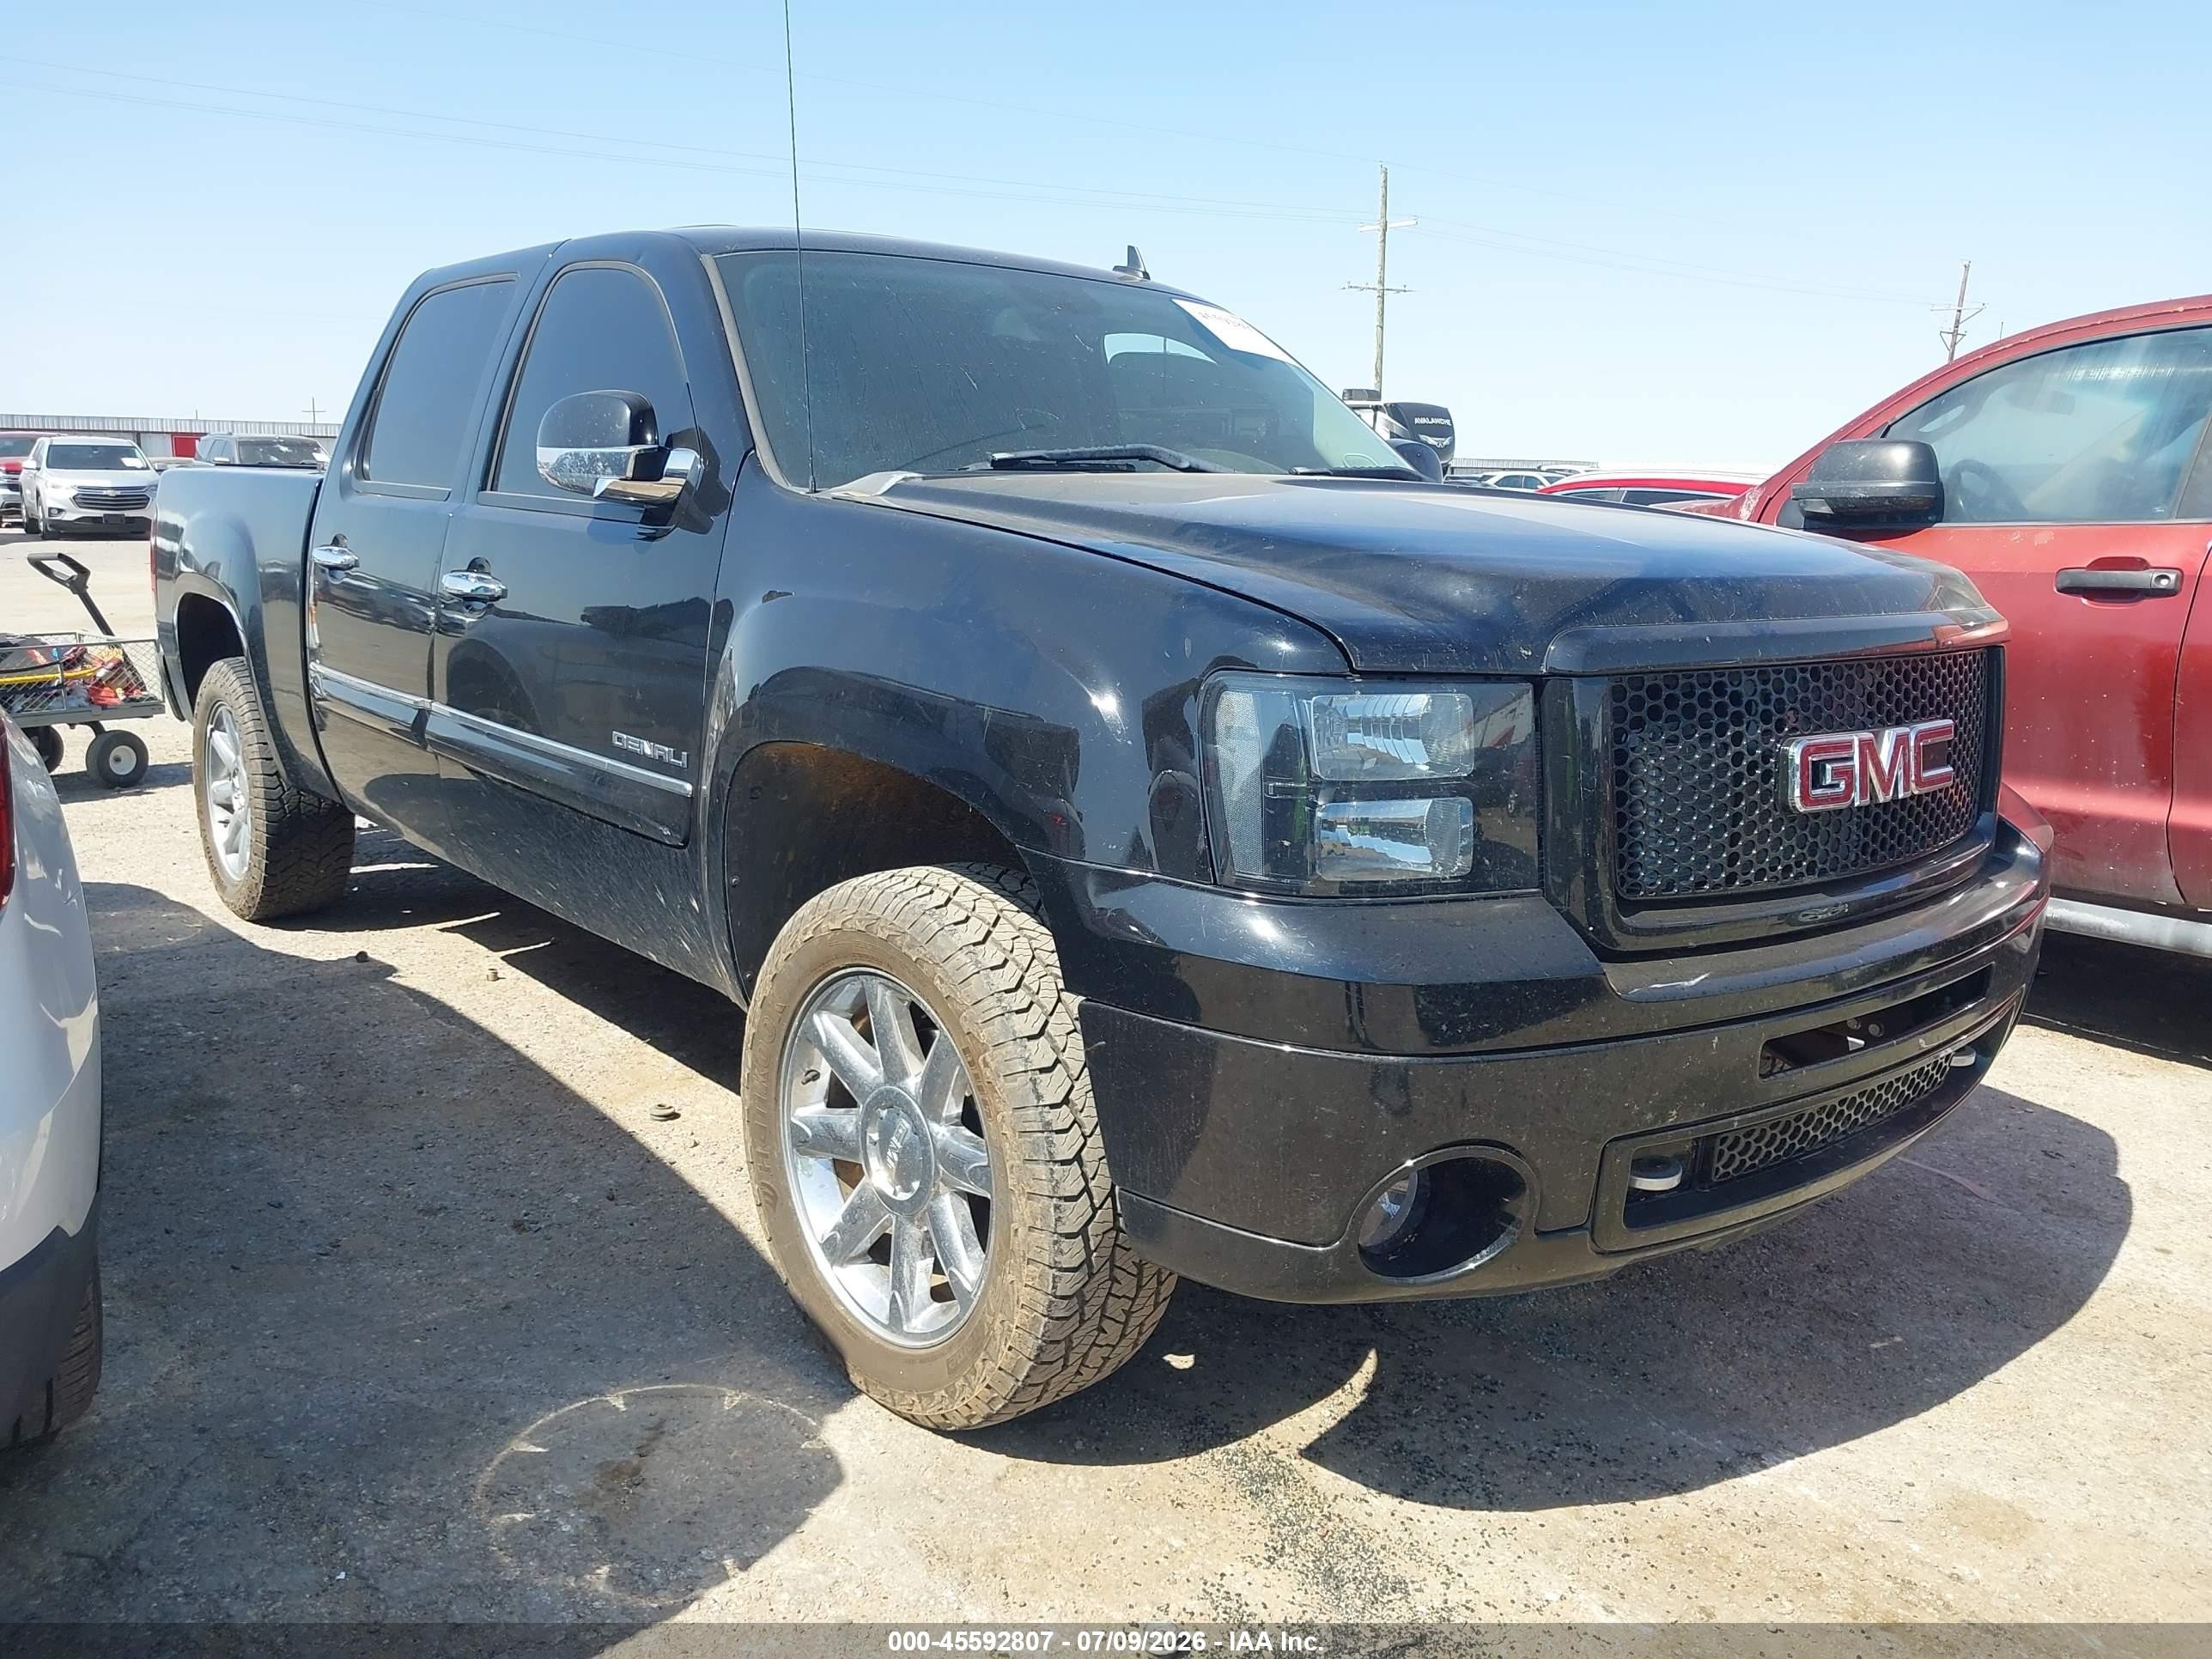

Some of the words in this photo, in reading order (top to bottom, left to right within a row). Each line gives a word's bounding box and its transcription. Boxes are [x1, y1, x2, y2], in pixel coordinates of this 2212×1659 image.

[1414, 416, 1451, 426] AVALANCHE
[611, 730, 688, 769] DENALI
[1788, 718, 1954, 813] GMC
